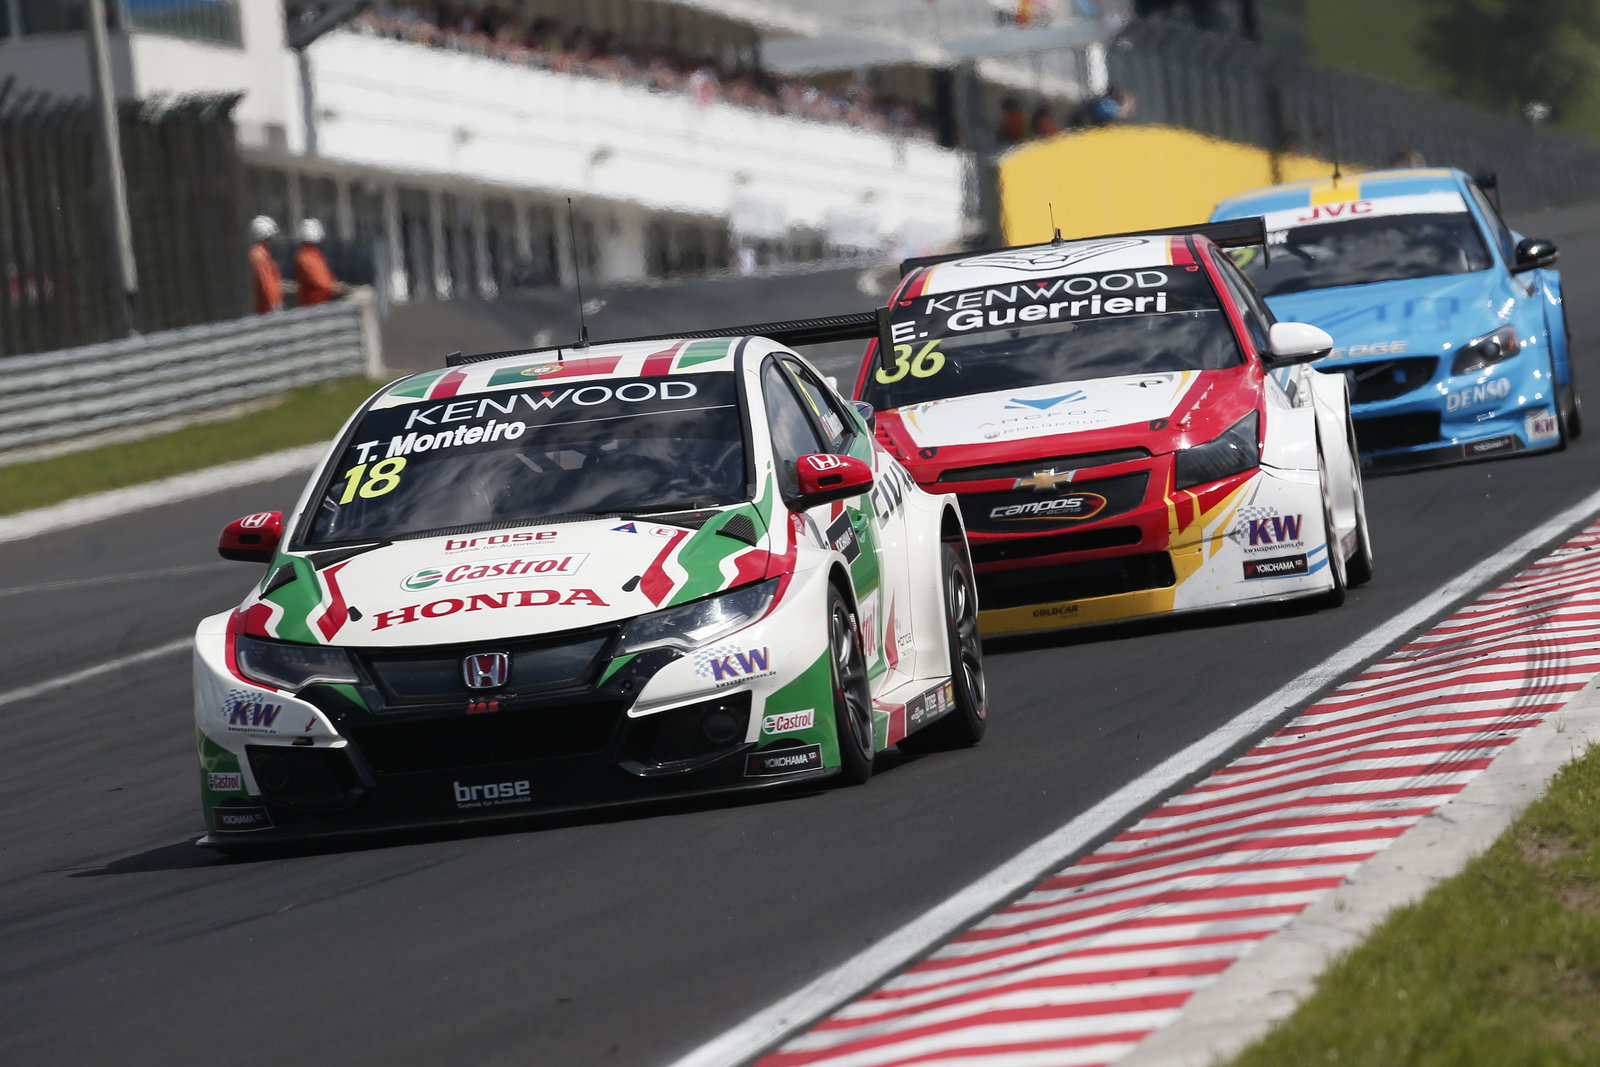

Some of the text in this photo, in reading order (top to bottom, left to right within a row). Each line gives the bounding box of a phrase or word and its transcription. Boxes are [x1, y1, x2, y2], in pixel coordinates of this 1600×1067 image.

[1298, 201, 1373, 222] JVC
[925, 271, 1168, 315] KENWOOD
[891, 291, 1167, 344] E. Guerrieri
[876, 338, 945, 384] 36
[1329, 340, 1408, 360] EDGE
[404, 381, 698, 429] KENWOOD
[1447, 377, 1510, 412] DENSO
[356, 419, 527, 464] T. Monteiro
[339, 457, 407, 506] 18
[990, 498, 1084, 519] campos
[445, 531, 558, 551] brose
[1249, 514, 1303, 546] KW
[445, 556, 573, 583] Castrol
[1256, 561, 1294, 573] YOKOHAMA
[372, 588, 610, 631] HONDA
[710, 646, 769, 682] KW
[229, 702, 282, 727] KW
[776, 711, 812, 731] Castrol
[764, 754, 808, 768] YOKOHAMA
[214, 774, 241, 789] Castrol
[453, 780, 530, 802] brose
